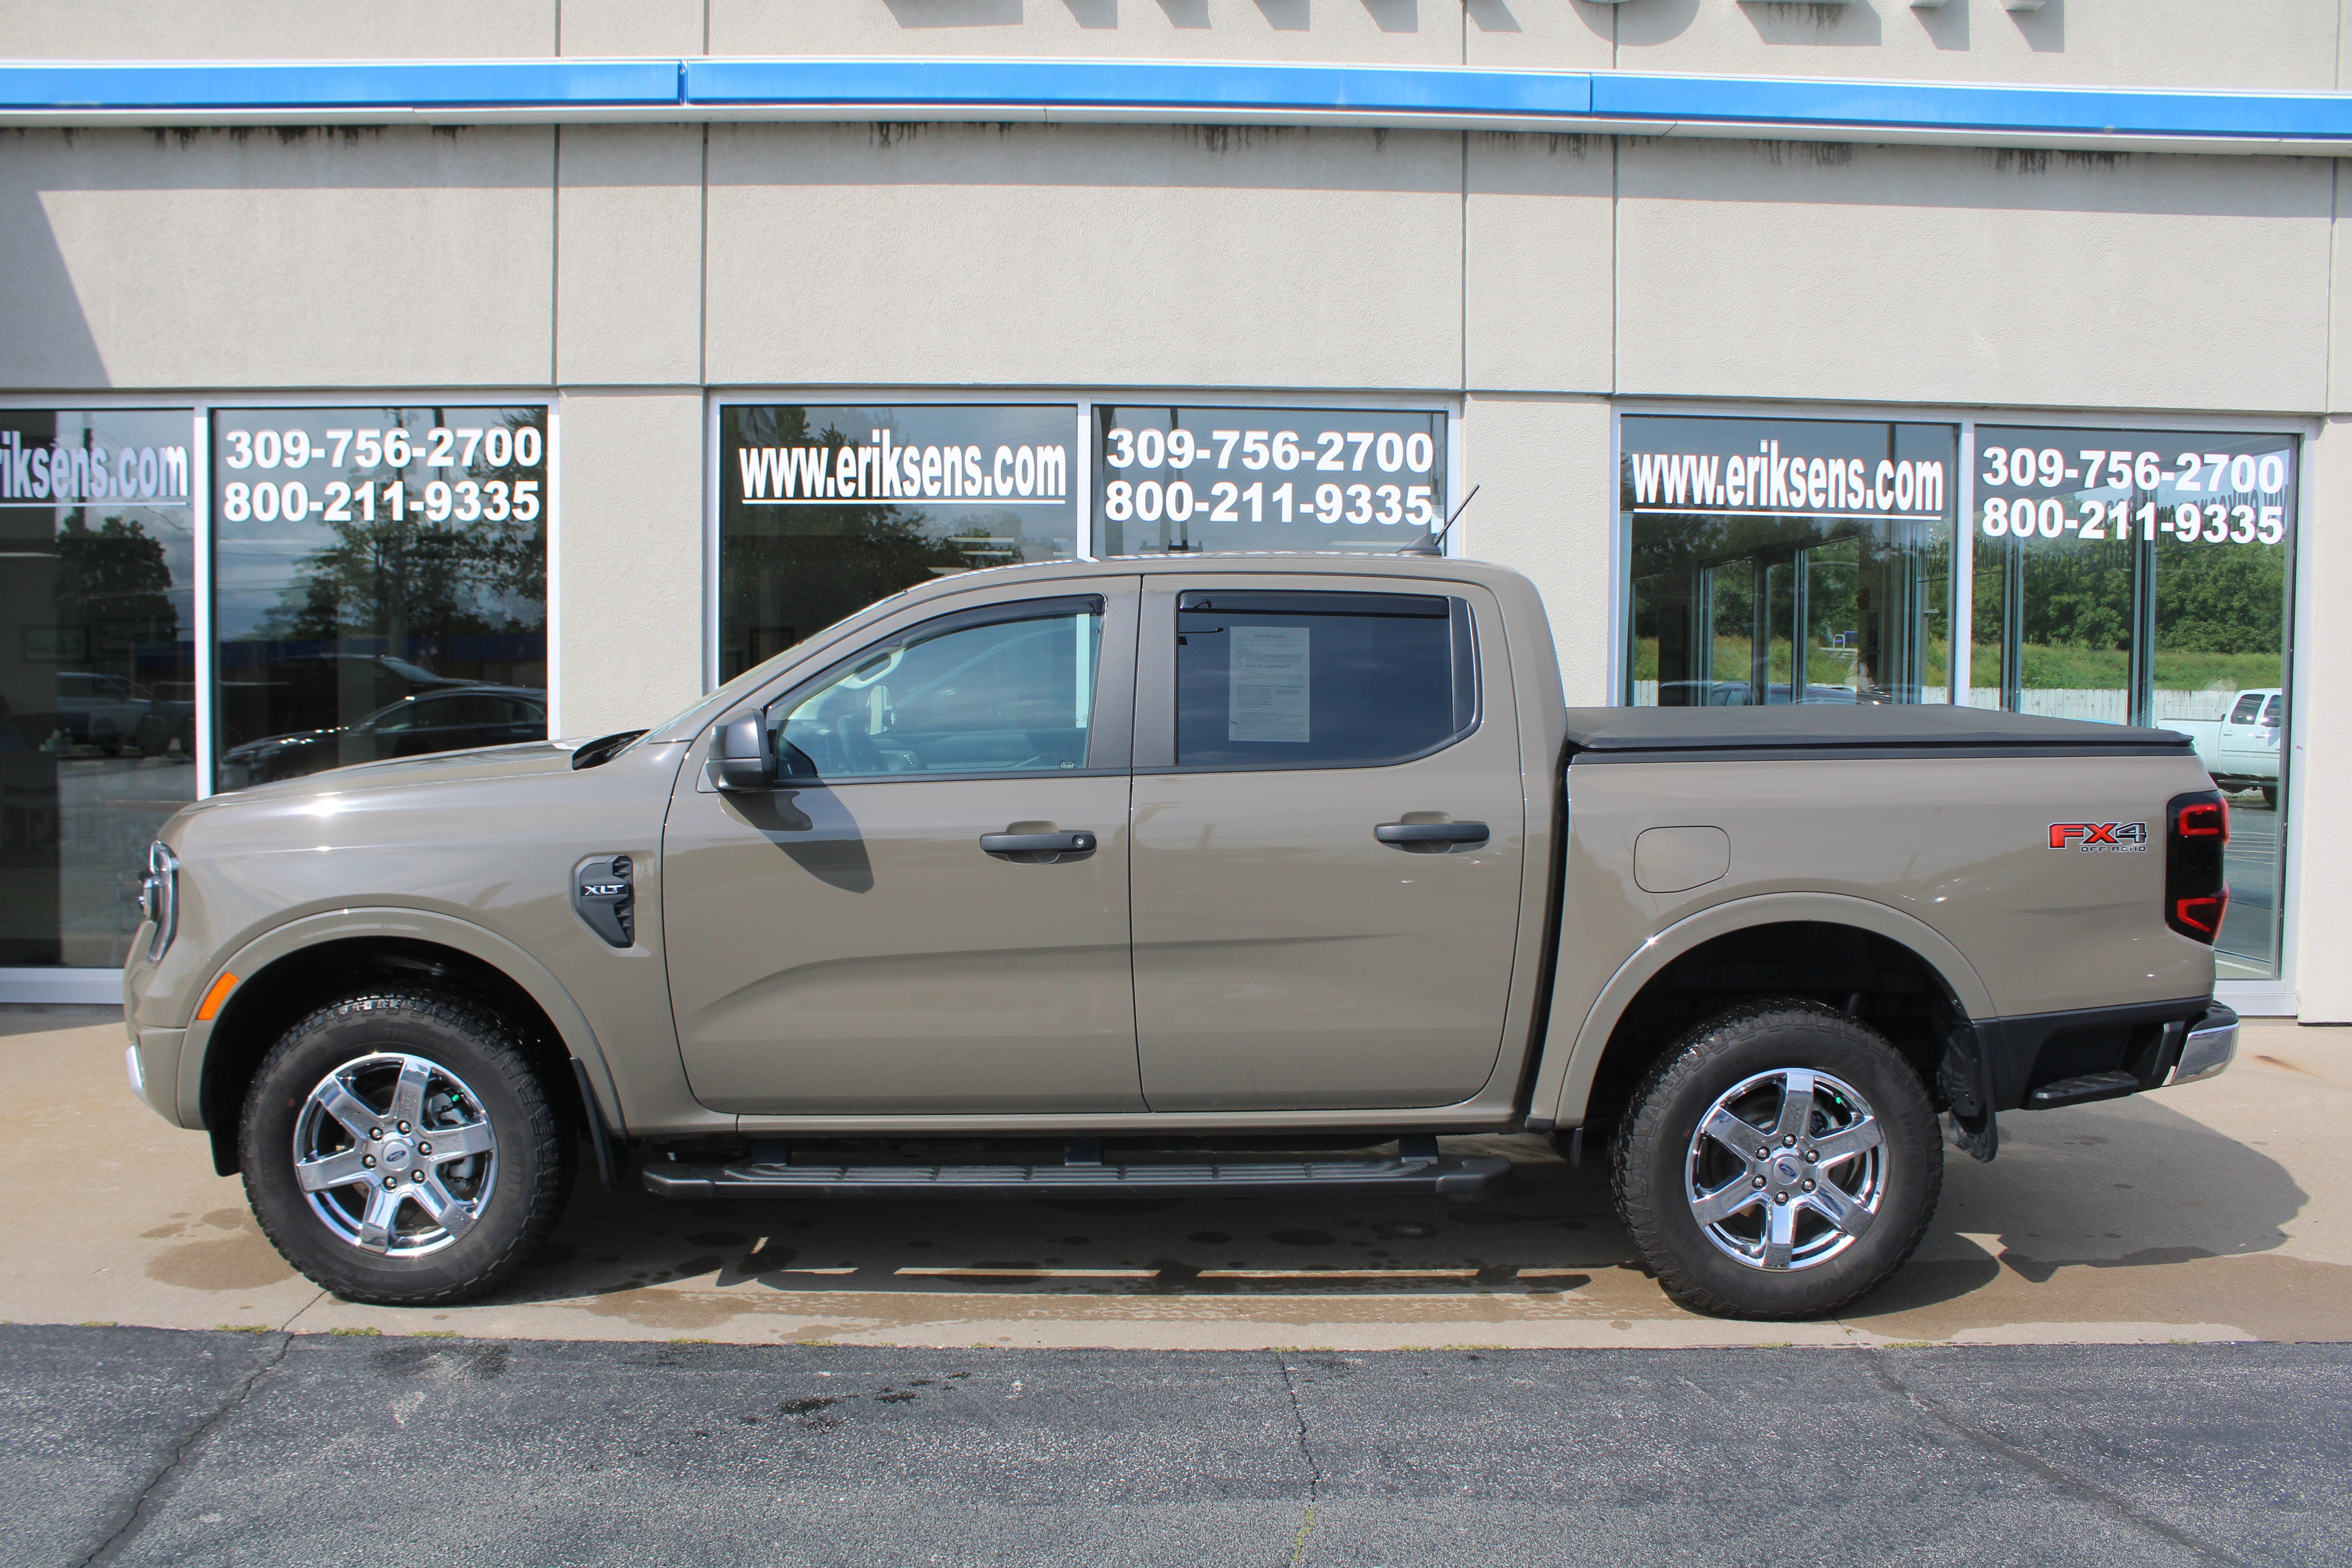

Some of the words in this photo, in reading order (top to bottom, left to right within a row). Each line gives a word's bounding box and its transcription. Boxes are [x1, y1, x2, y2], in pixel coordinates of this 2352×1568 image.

[0, 430, 188, 499] iksens.com
[226, 427, 542, 469] 309-756-2700
[739, 429, 1066, 498] www.eriksens.com
[1107, 428, 1434, 473] 309-756-2700
[1982, 447, 2284, 494] 309-756-2700
[1632, 439, 1944, 511] www.eriksens.com
[224, 480, 540, 522] 800-211-9335
[1105, 481, 1432, 526] 800-211-9335
[1982, 497, 2283, 545] 800-211-9335
[2047, 822, 2147, 849] FX4
[584, 884, 625, 895] XLT
